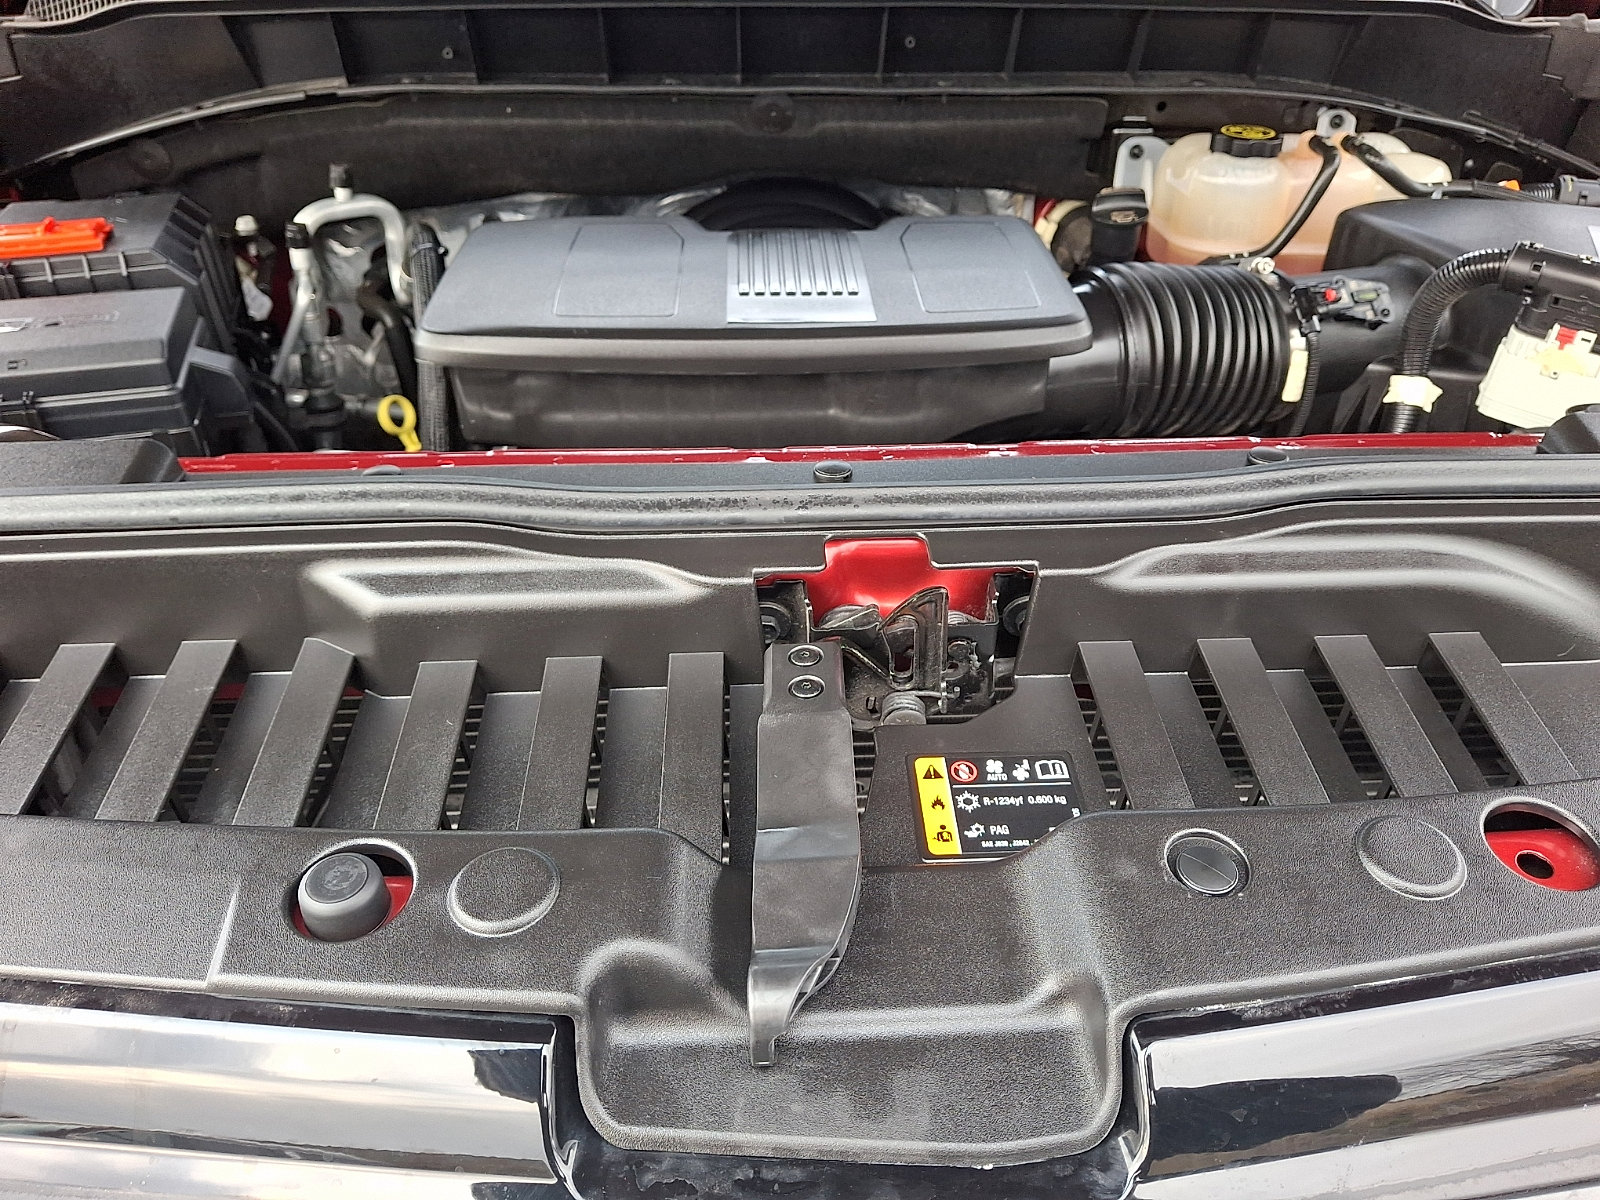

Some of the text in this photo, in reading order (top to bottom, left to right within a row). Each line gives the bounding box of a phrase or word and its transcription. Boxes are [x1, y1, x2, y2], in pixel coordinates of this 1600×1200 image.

[987, 773, 1008, 781] AUTO
[983, 796, 1023, 806] R-1234yf
[1054, 795, 1067, 805] kg
[989, 824, 1010, 835] PAG
